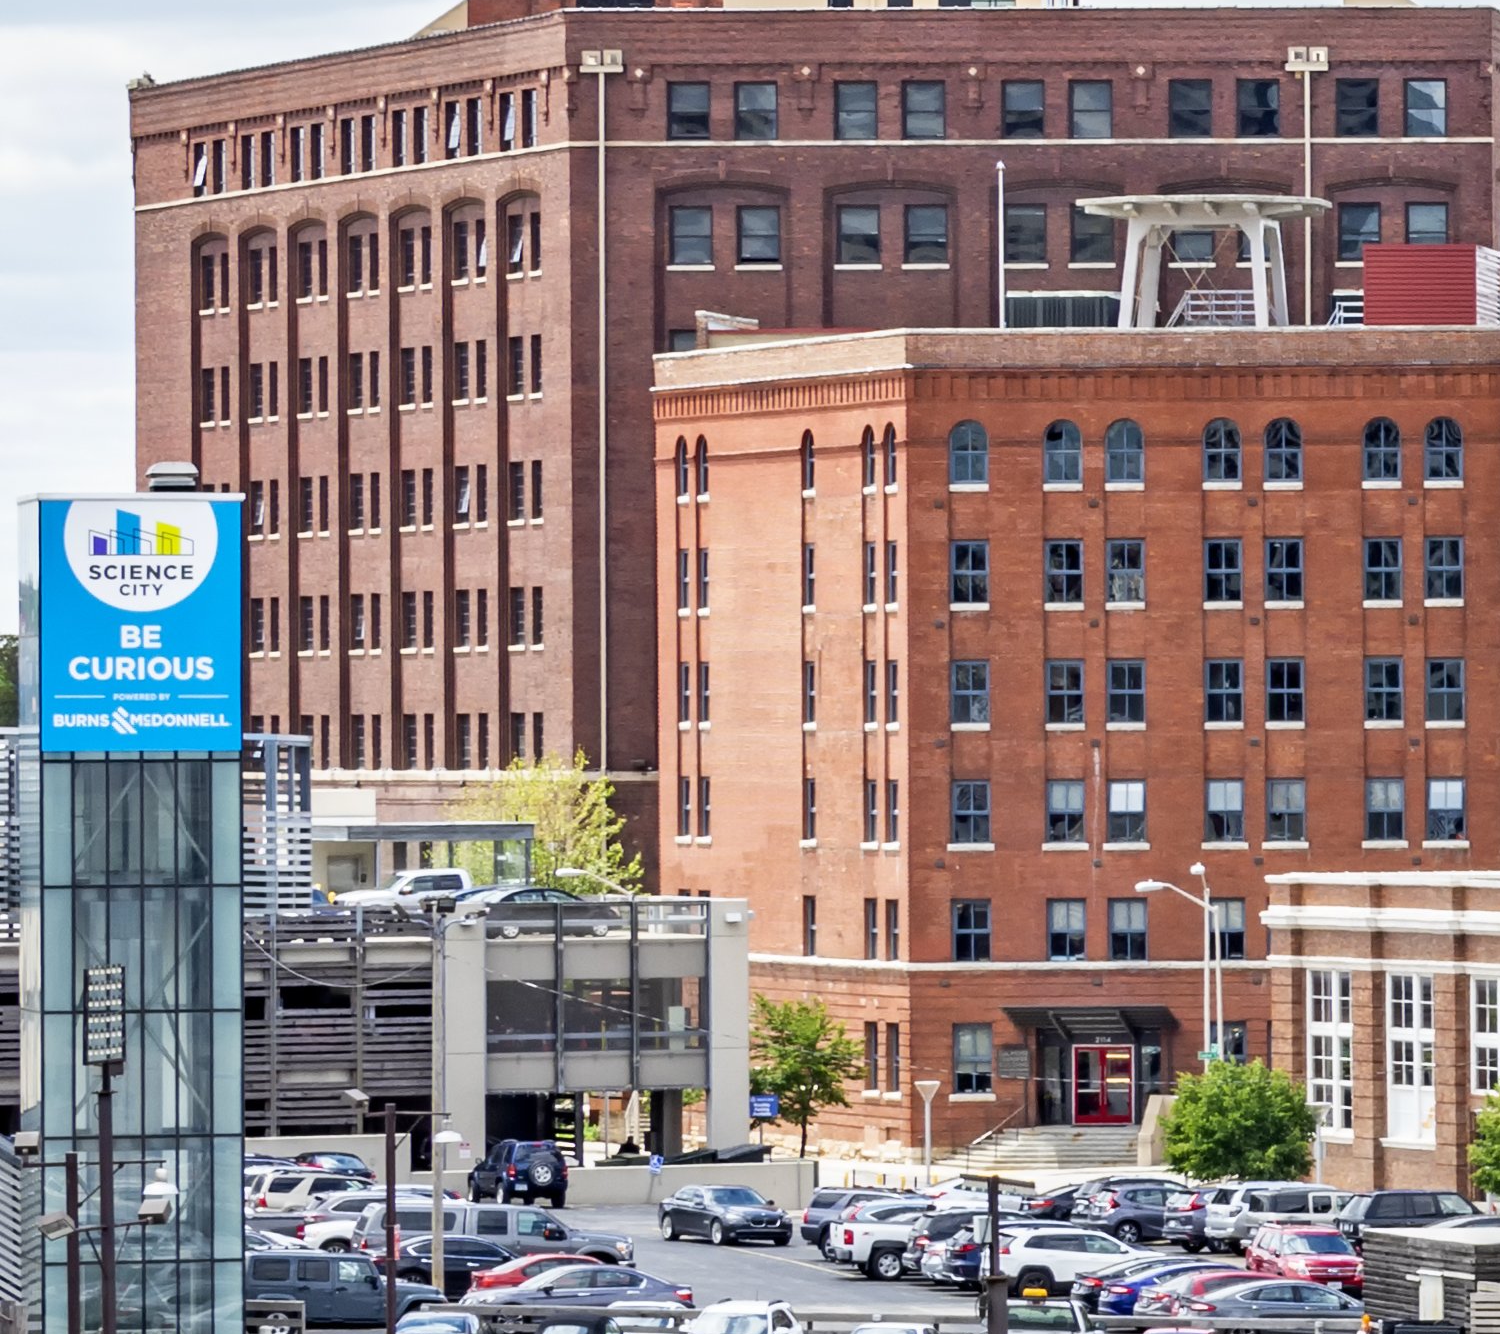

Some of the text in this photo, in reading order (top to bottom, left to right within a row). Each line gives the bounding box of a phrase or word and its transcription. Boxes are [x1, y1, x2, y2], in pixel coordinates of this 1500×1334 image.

[88, 564, 194, 580] SCIENCE
[119, 583, 164, 596] CITY
[120, 624, 162, 649] BE
[68, 656, 215, 681] CURIOUS
[113, 693, 171, 701] POWERED BY
[53, 713, 110, 728] BURNS
